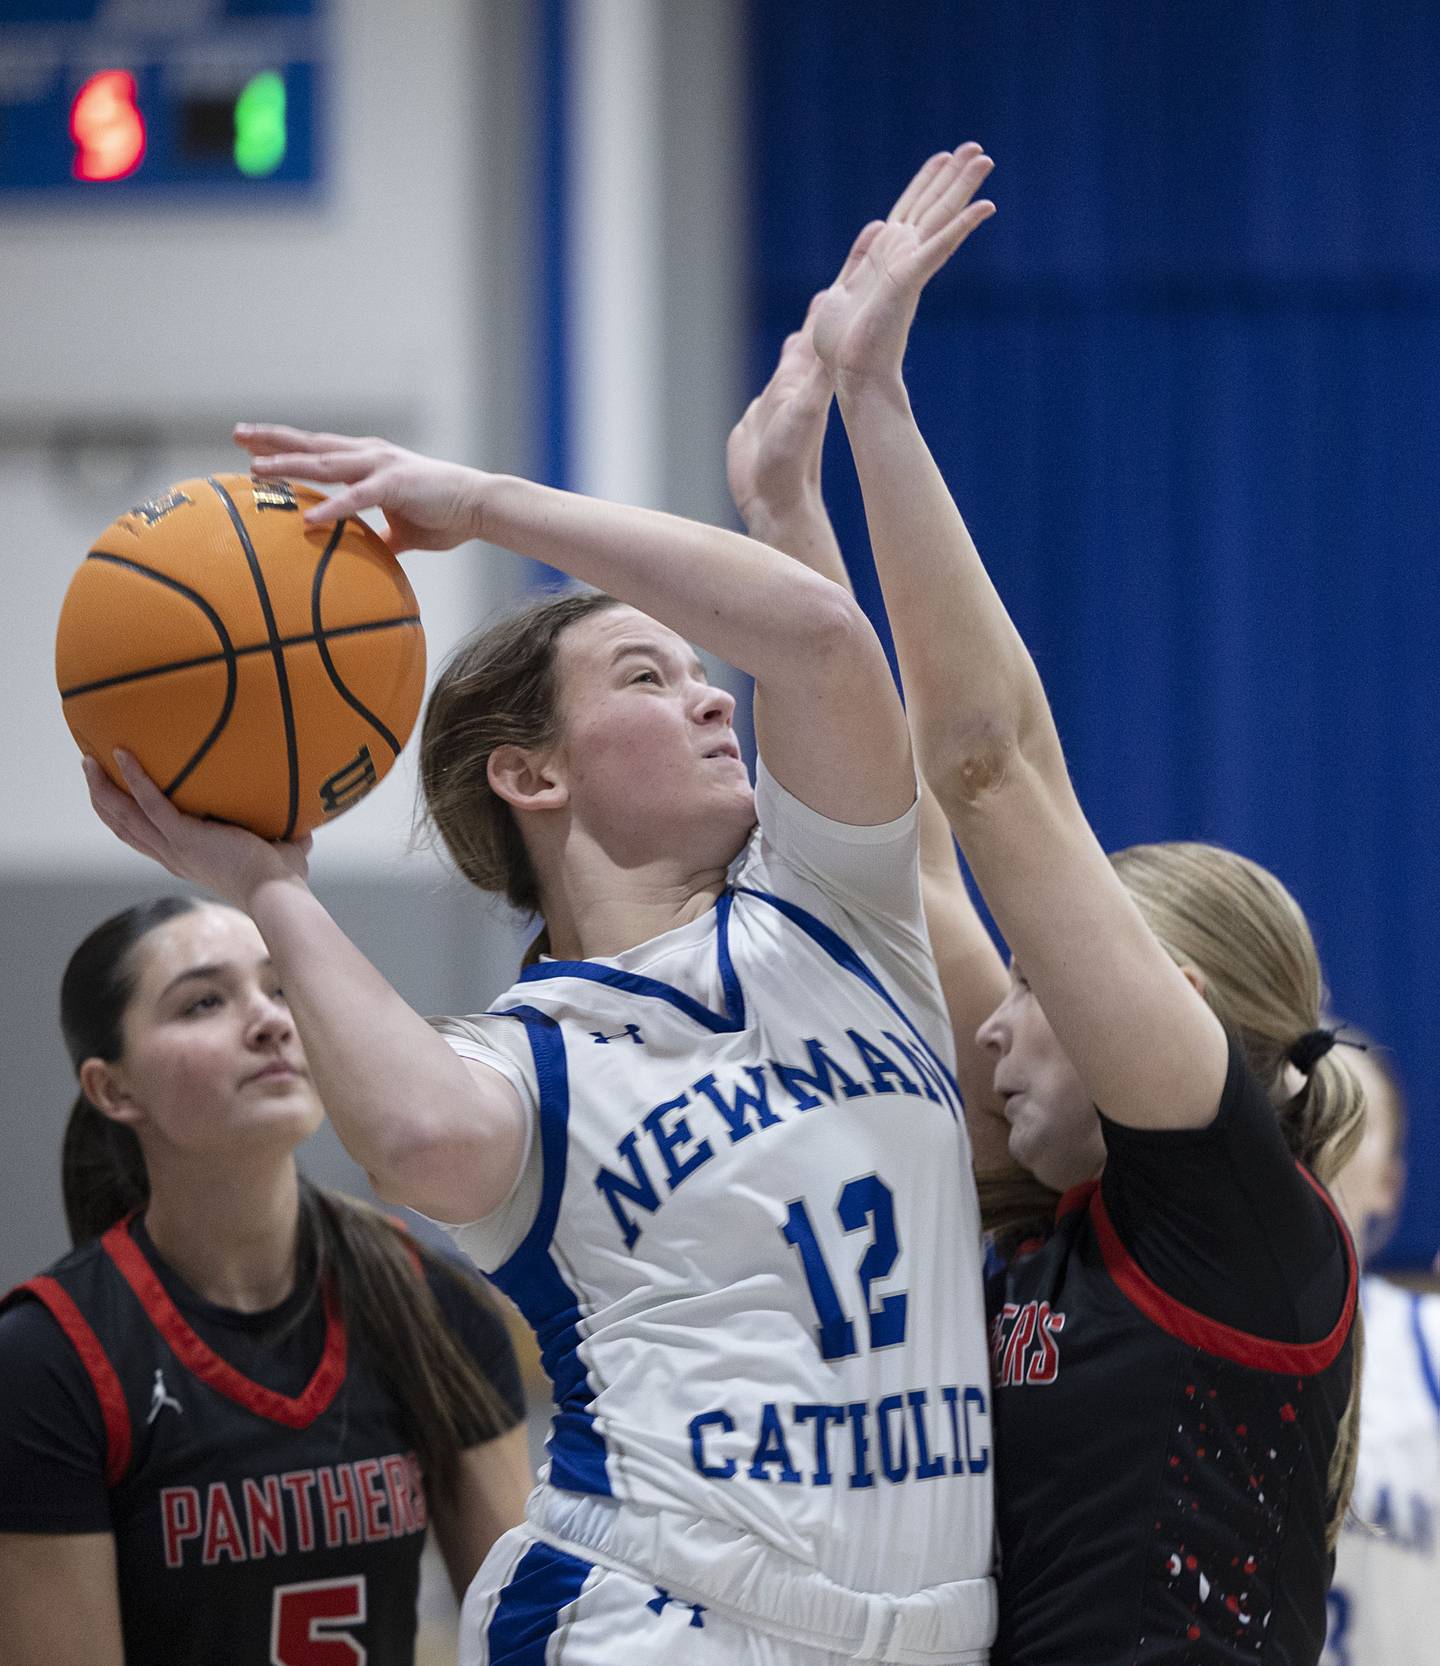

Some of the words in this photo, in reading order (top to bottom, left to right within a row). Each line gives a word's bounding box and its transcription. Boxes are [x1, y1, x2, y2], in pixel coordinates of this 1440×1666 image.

[593, 1027, 960, 1253] NEWMAN
[778, 1171, 908, 1362] 12
[269, 1574, 366, 1666] 5
